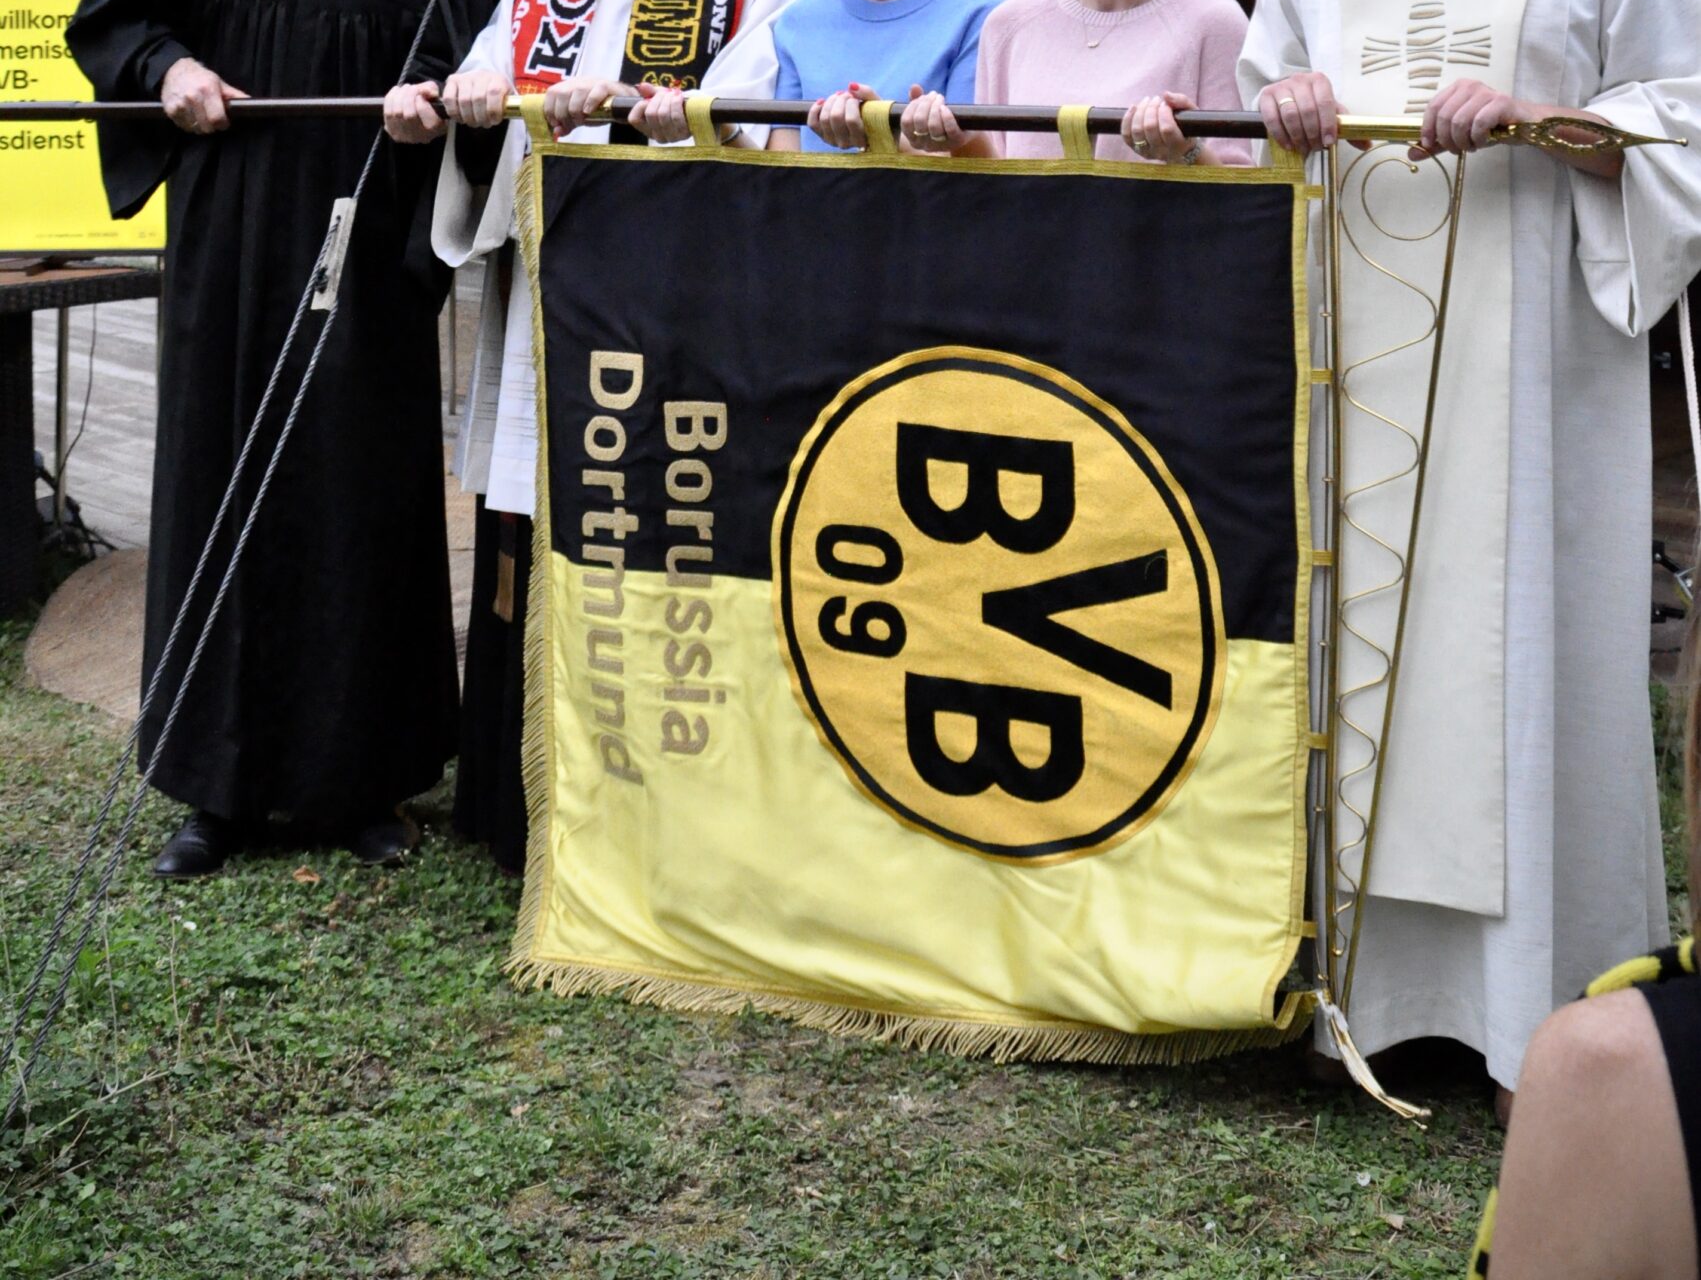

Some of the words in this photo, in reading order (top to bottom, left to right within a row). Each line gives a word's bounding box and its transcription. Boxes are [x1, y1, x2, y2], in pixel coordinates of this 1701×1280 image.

[582, 350, 644, 786] Dortmund
[661, 401, 728, 756] Borussia
[815, 524, 907, 658] 09
[896, 422, 1172, 803] BVB
